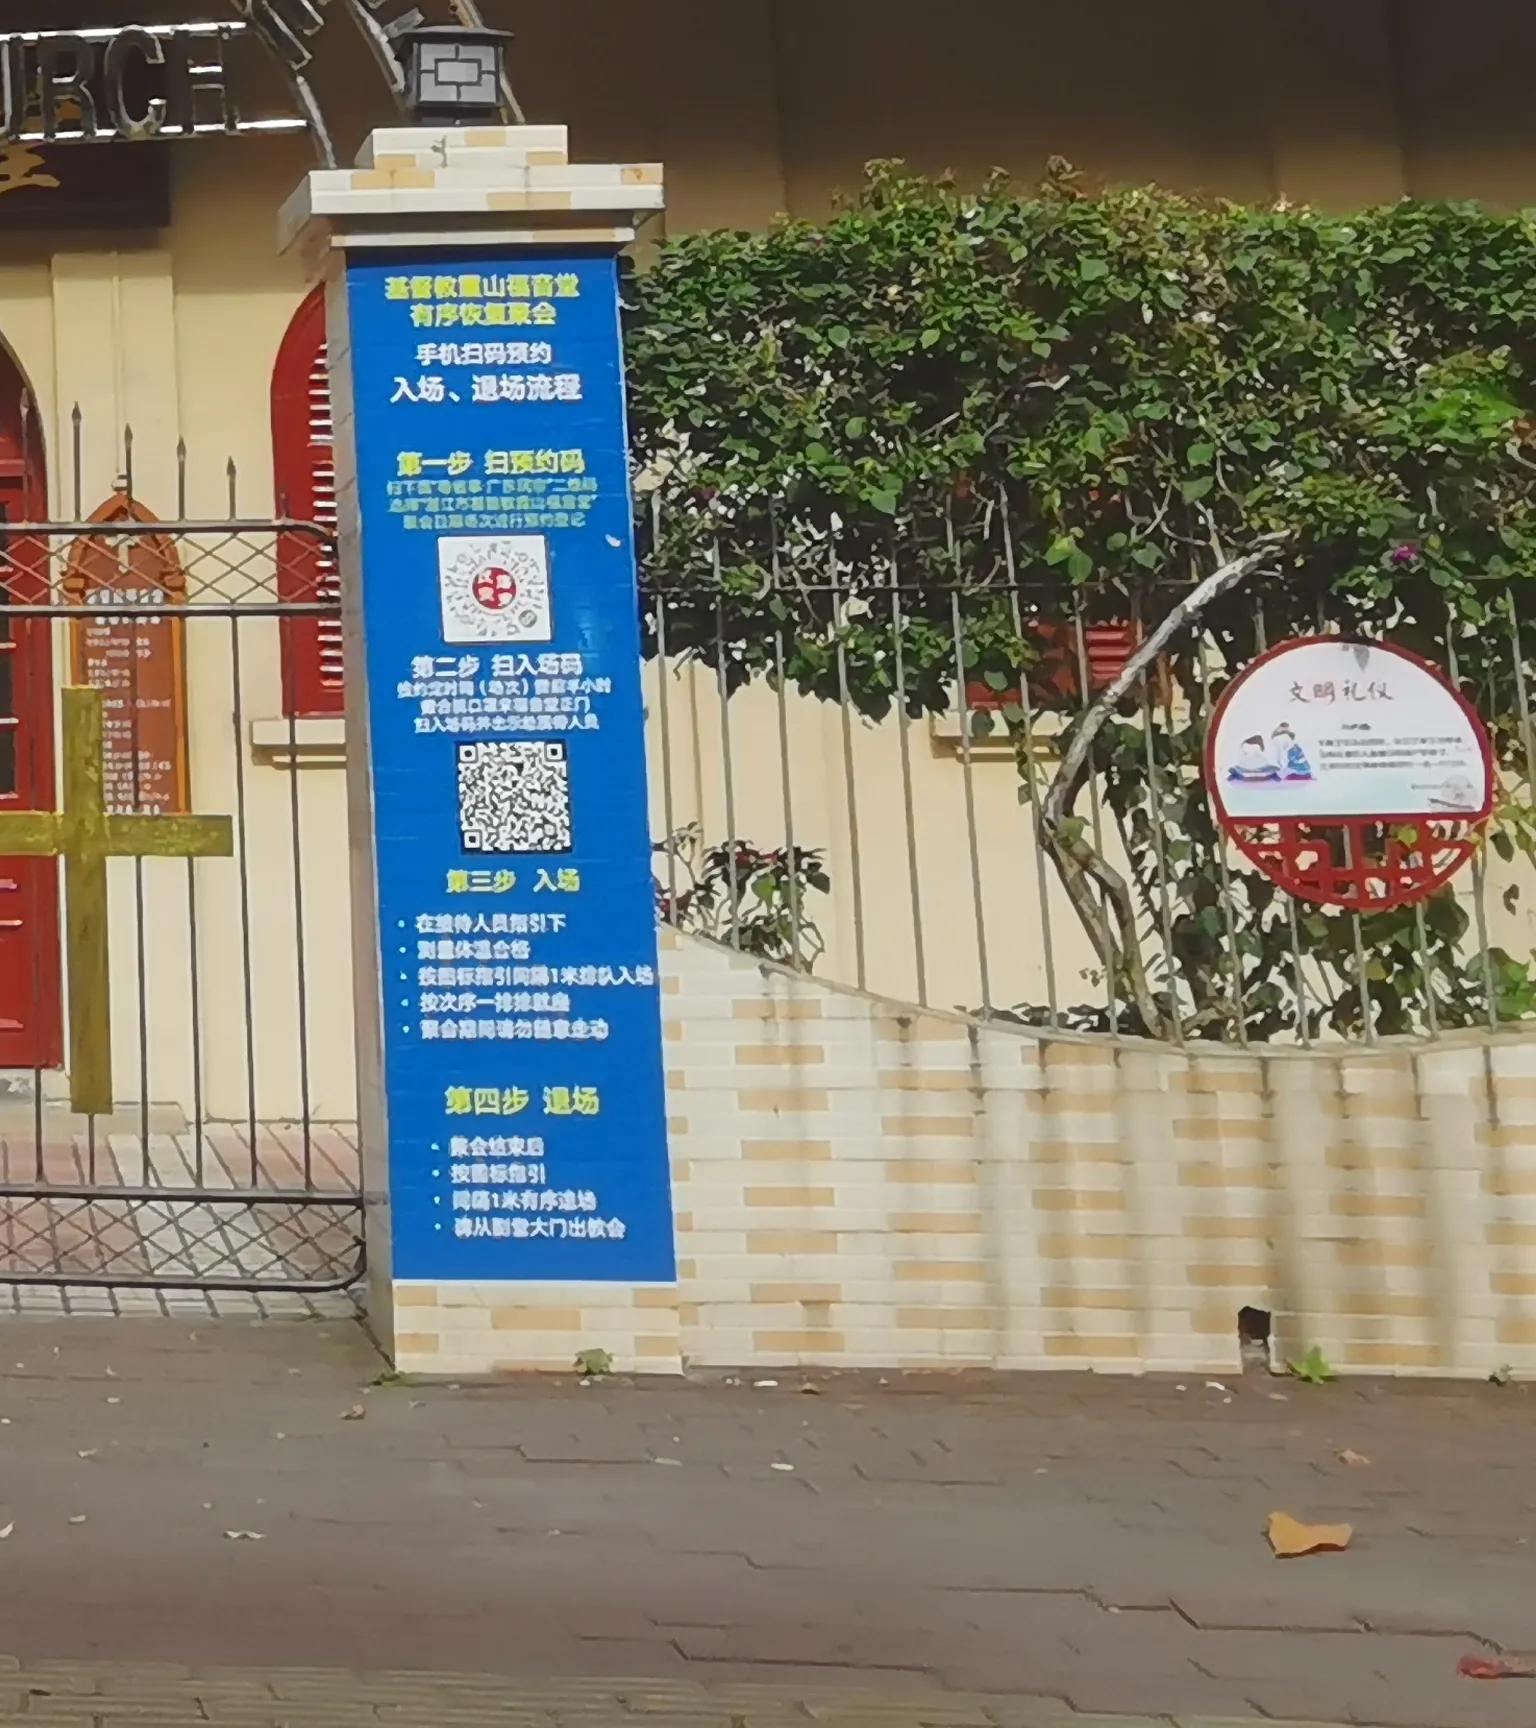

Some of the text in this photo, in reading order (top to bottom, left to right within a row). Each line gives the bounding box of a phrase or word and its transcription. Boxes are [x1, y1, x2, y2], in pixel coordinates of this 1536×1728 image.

[390, 373, 583, 403] 入场、退场流程
[396, 450, 474, 477] 第一步
[411, 654, 480, 680] 第二步
[1288, 681, 1394, 704] 文明礼仪
[446, 868, 580, 893] 第三步 入场
[444, 1085, 600, 1116] 第四步 退场
